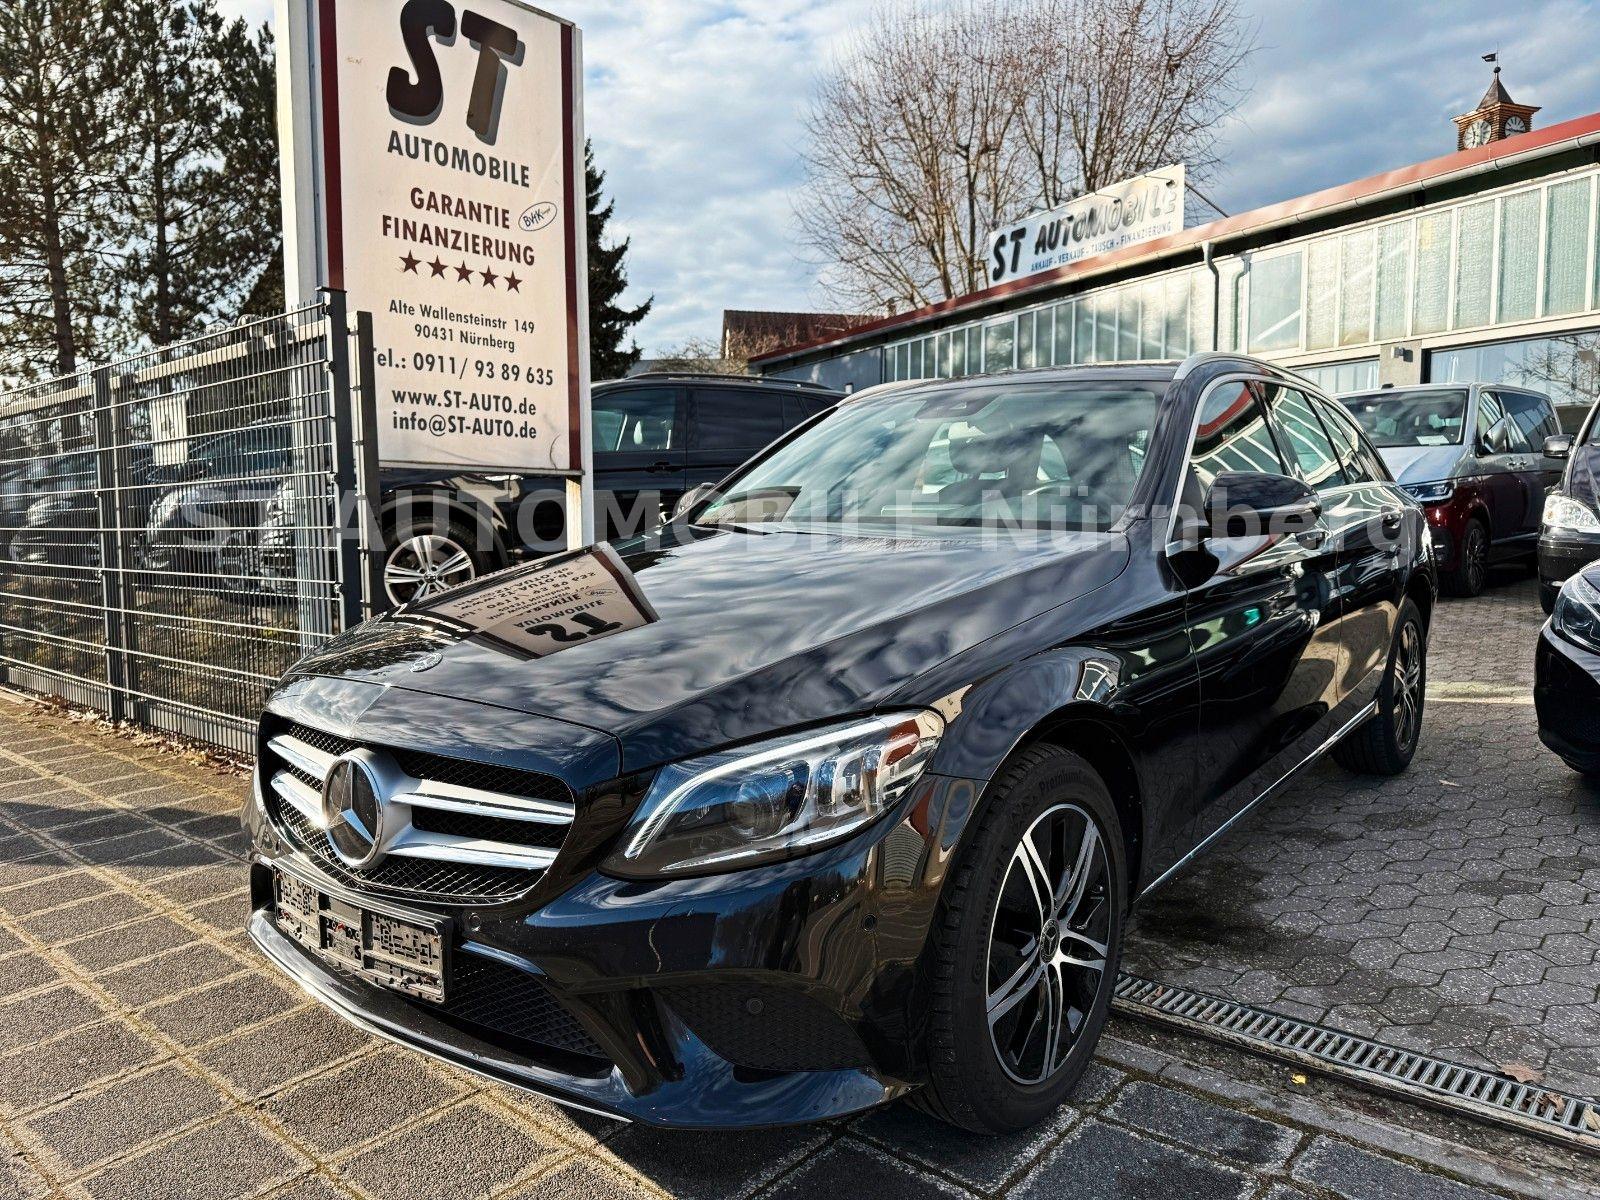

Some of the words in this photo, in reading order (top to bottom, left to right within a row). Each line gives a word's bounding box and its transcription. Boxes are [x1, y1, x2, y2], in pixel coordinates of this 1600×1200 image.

[386, 0, 526, 146] ST
[387, 130, 530, 188] AUTOMOBILE
[410, 187, 511, 229] GARANTIE
[382, 214, 535, 266] FINANZIERUNG
[992, 227, 1027, 281] ST
[389, 299, 415, 316] Alte
[420, 303, 507, 330] Wallensteinstr
[514, 318, 535, 334] 149
[414, 323, 454, 342] 90431
[460, 329, 515, 353] Nürnberg
[373, 346, 406, 369] el.:
[475, 360, 495, 379] 93
[502, 364, 520, 381] 89
[526, 367, 554, 386] 635
[392, 389, 537, 416] www.ST-AUTO.de
[393, 411, 537, 439] info@ST-AUTO.de
